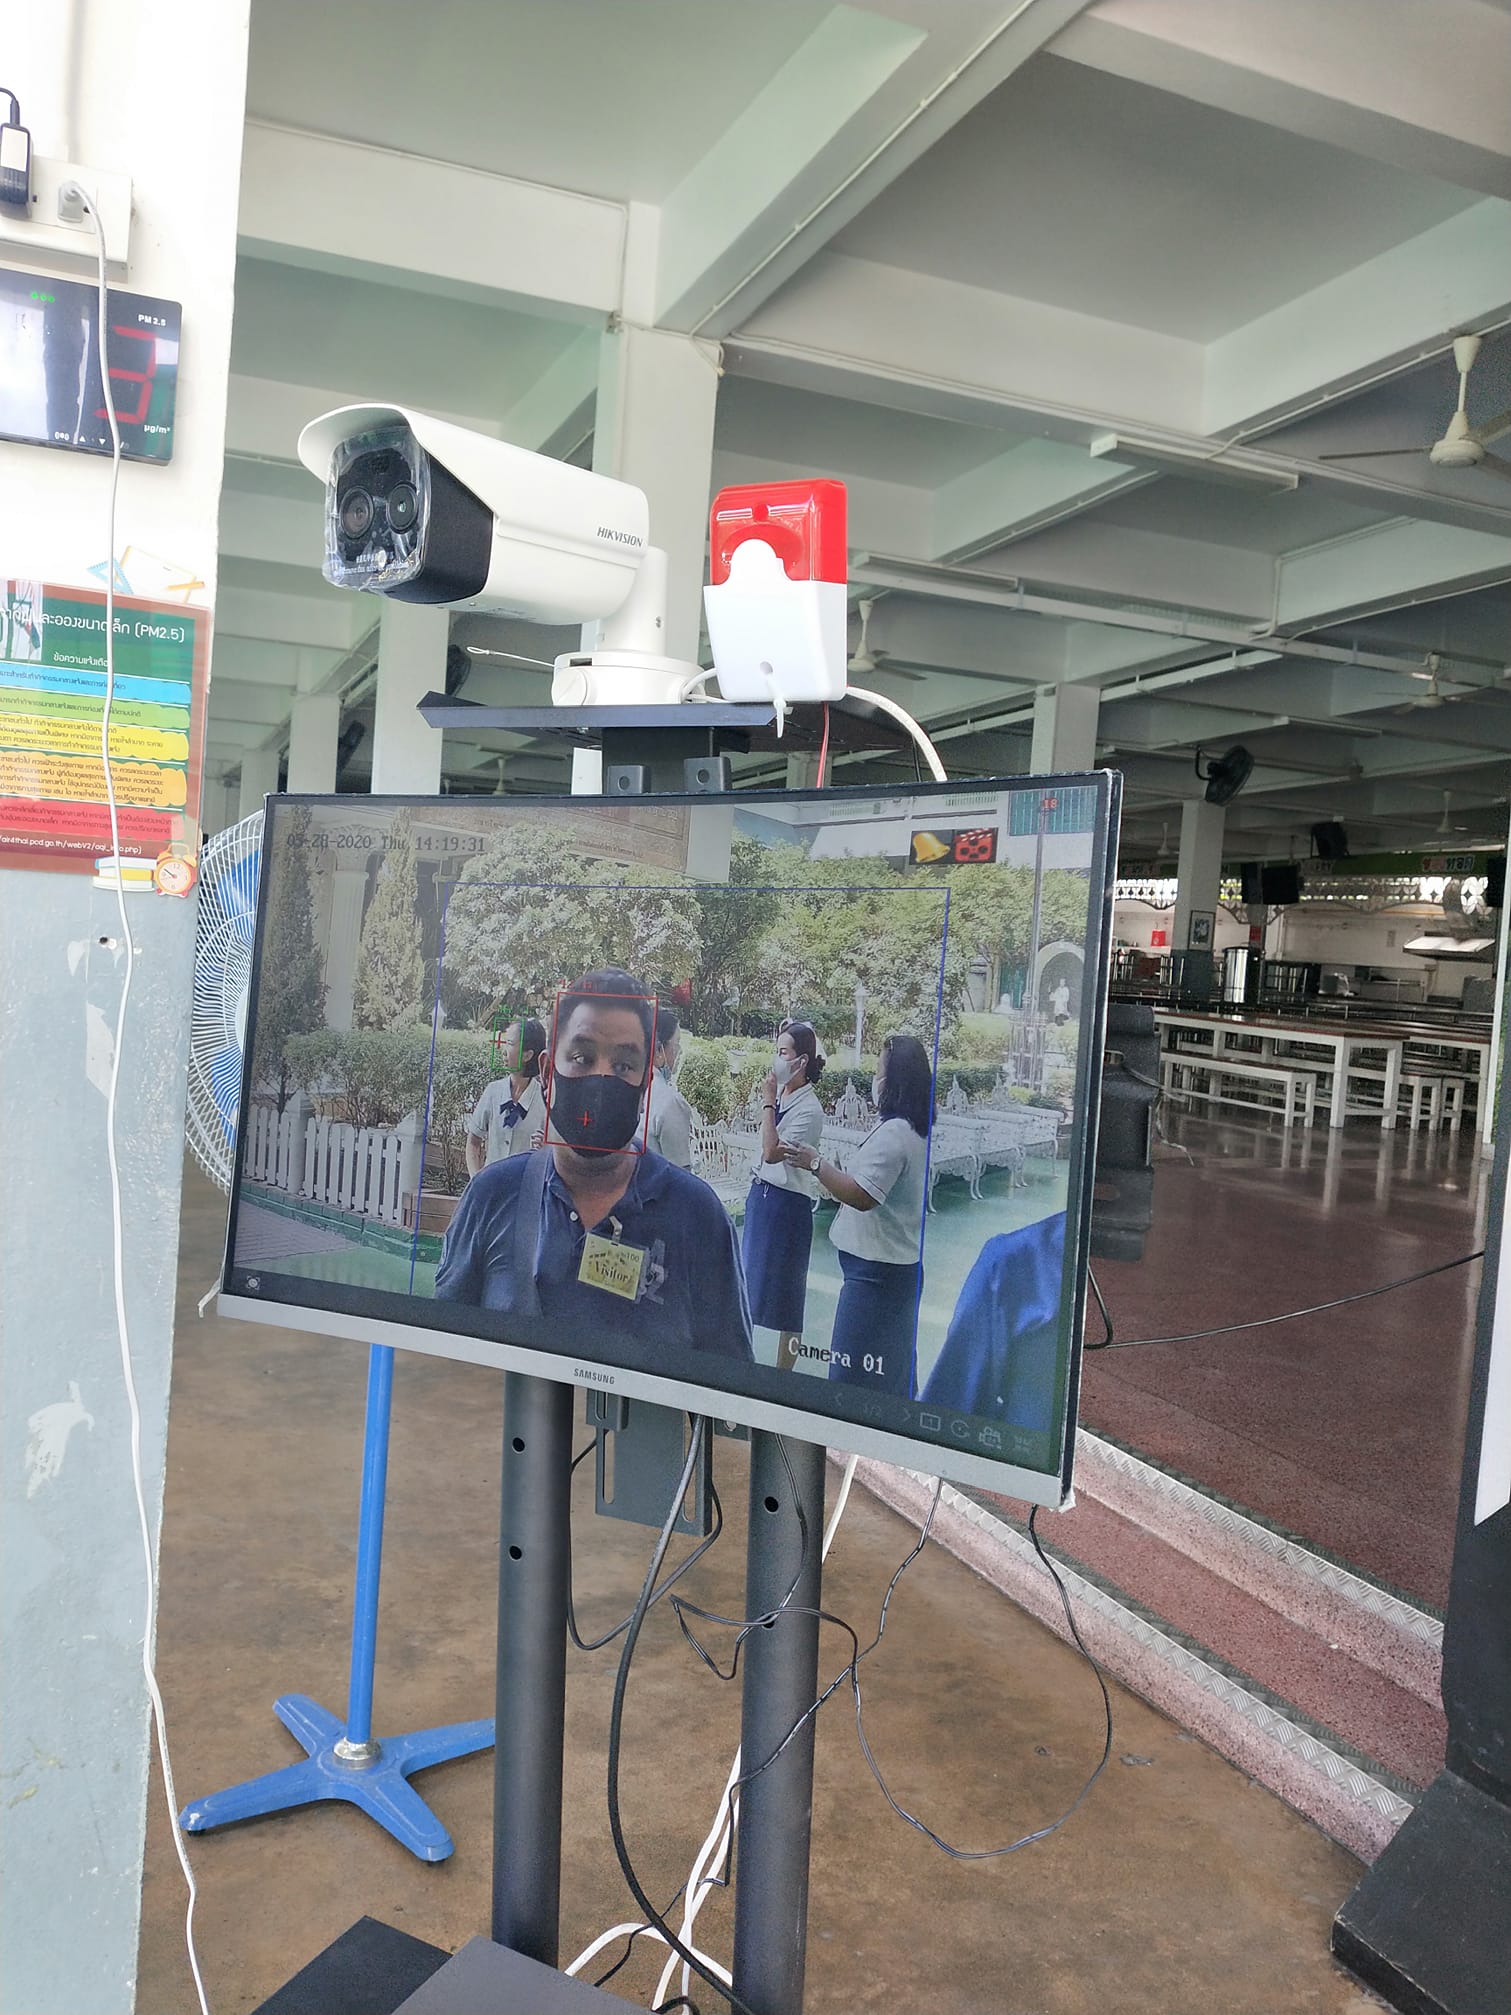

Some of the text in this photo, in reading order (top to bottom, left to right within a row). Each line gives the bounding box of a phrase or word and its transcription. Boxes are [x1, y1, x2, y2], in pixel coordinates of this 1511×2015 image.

[597, 526, 643, 548] HIKVISION
[135, 621, 185, 643] (PM2.5)
[415, 836, 485, 851] 14:19:31
[787, 1336, 885, 1375] Camera 01
[574, 1368, 615, 1385] SAMSUNG
